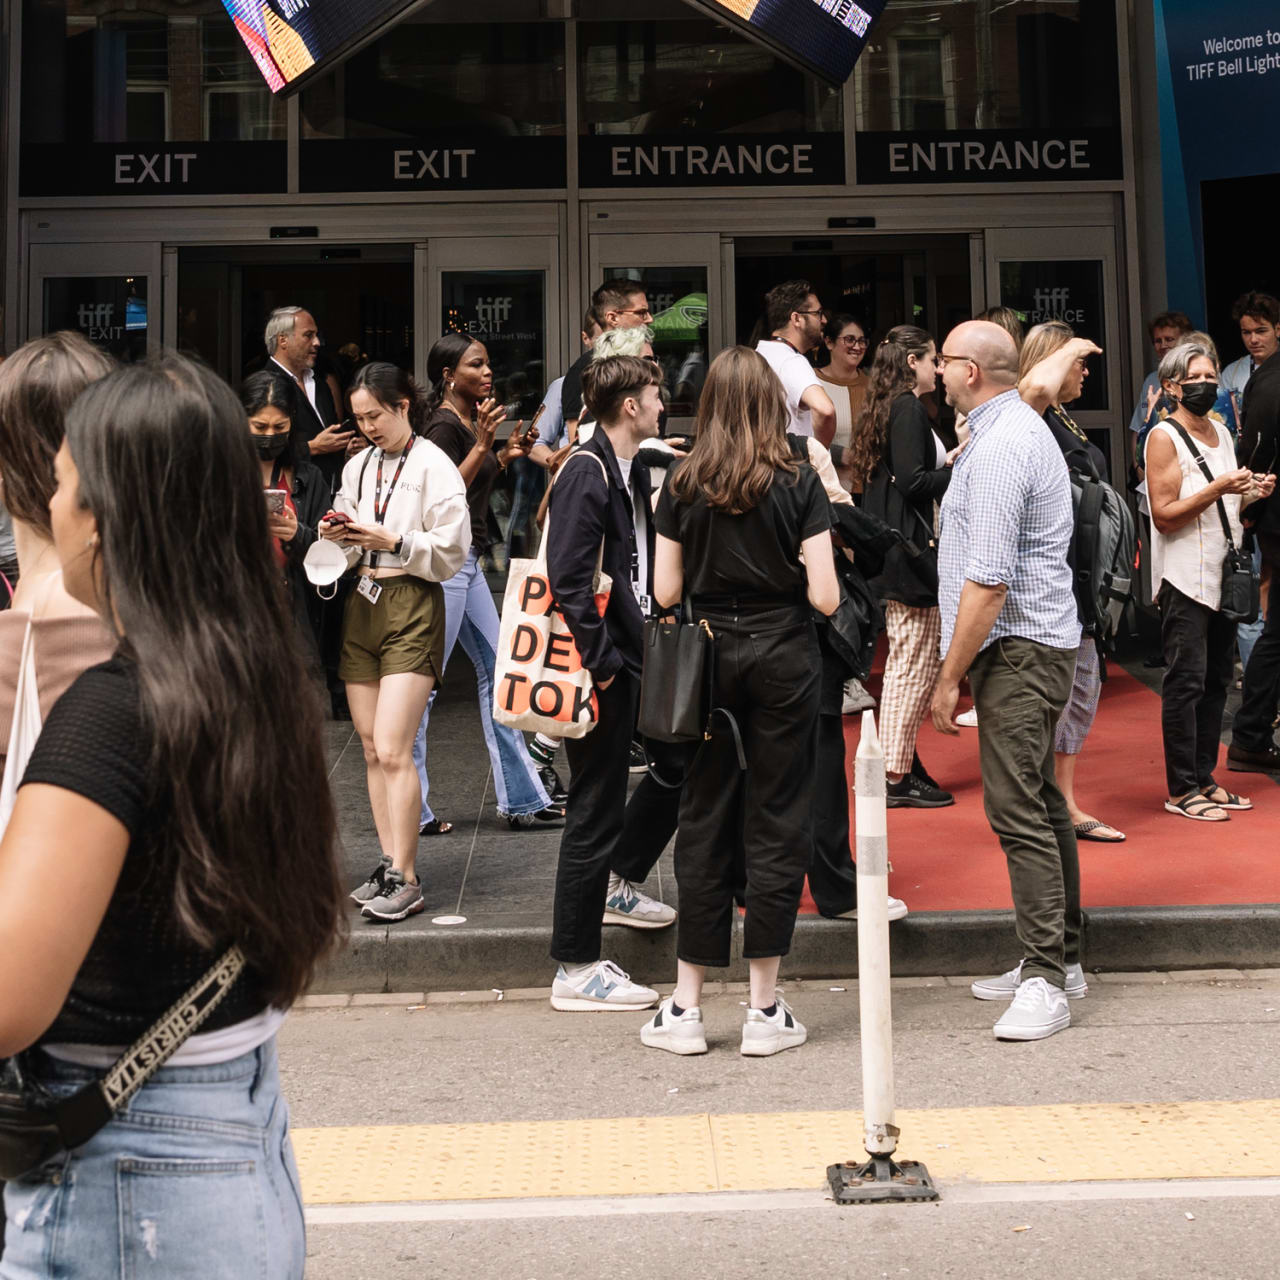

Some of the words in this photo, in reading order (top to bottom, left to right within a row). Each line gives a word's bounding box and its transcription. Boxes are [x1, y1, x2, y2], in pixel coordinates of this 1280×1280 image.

[1203, 33, 1263, 55] Welcome
[1266, 30, 1280, 45] to
[1186, 62, 1216, 81] TIFF
[1218, 58, 1243, 77] Bell
[114, 153, 196, 184] EXIT
[393, 149, 475, 180] EXIT
[612, 144, 814, 176] ENTRANCE
[888, 140, 1090, 173] ENTRANCE
[475, 297, 512, 320] tiff
[1033, 288, 1070, 311] tiff
[77, 303, 114, 327] tiff
[468, 320, 504, 333] EXIT
[89, 326, 124, 339] EXIT
[511, 624, 573, 672] DE
